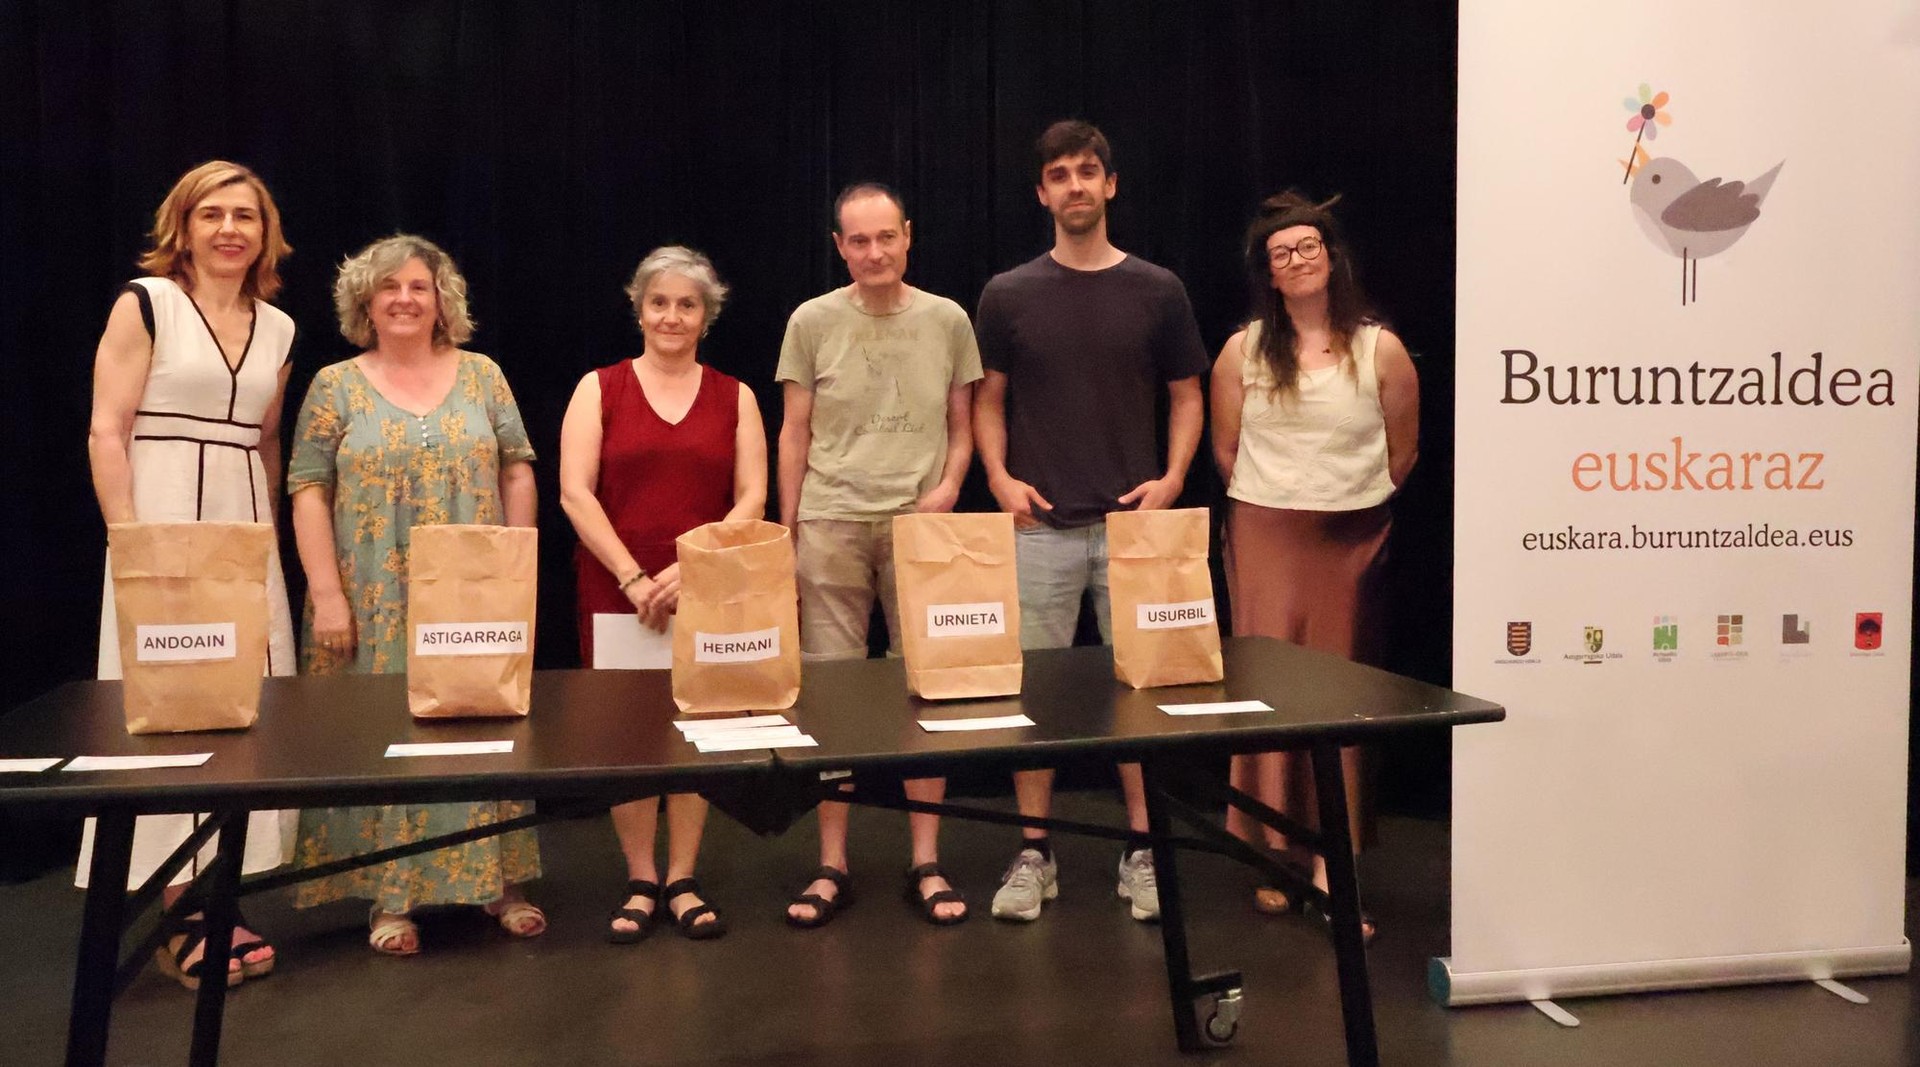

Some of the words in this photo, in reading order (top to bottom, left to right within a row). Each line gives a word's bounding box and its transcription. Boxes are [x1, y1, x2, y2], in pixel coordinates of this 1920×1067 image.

[1500, 349, 1896, 407] Buruntzaldea
[1571, 435, 1826, 492] euskaraz
[1522, 522, 1854, 551] euskara.buruntzaldea.eus
[933, 612, 998, 627] URNIETA
[1147, 606, 1208, 623] USURBIL
[143, 634, 226, 650] ANDOAIN
[422, 630, 523, 645] ASTIGARRAGA
[703, 637, 773, 654] HERNANI
